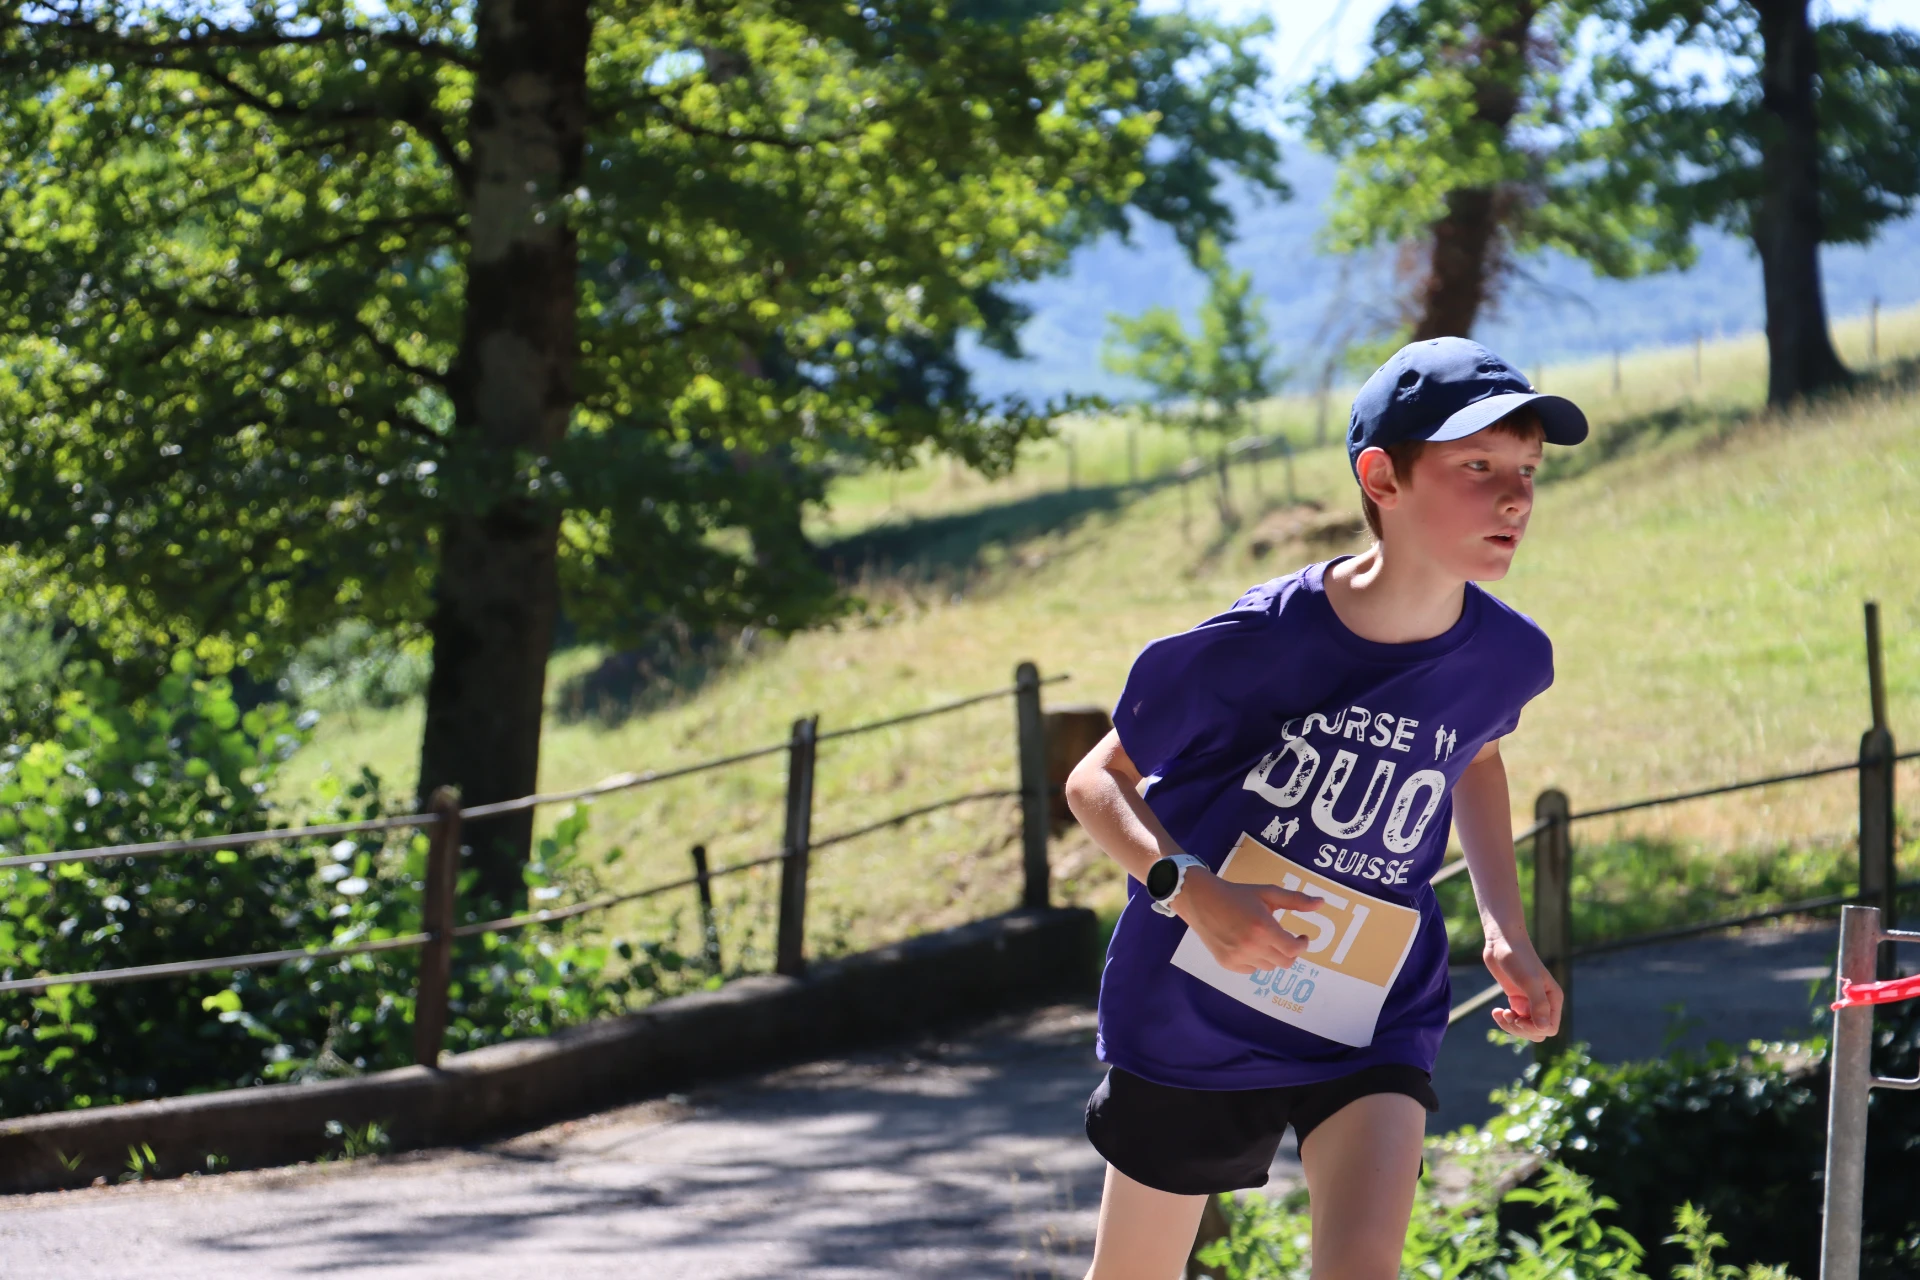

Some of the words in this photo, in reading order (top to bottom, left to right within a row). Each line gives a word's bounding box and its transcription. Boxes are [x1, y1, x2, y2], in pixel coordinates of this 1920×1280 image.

[1242, 736, 1446, 854] DUO
[1314, 843, 1414, 885] SUISSE
[1271, 995, 1304, 1014] SUISSE
